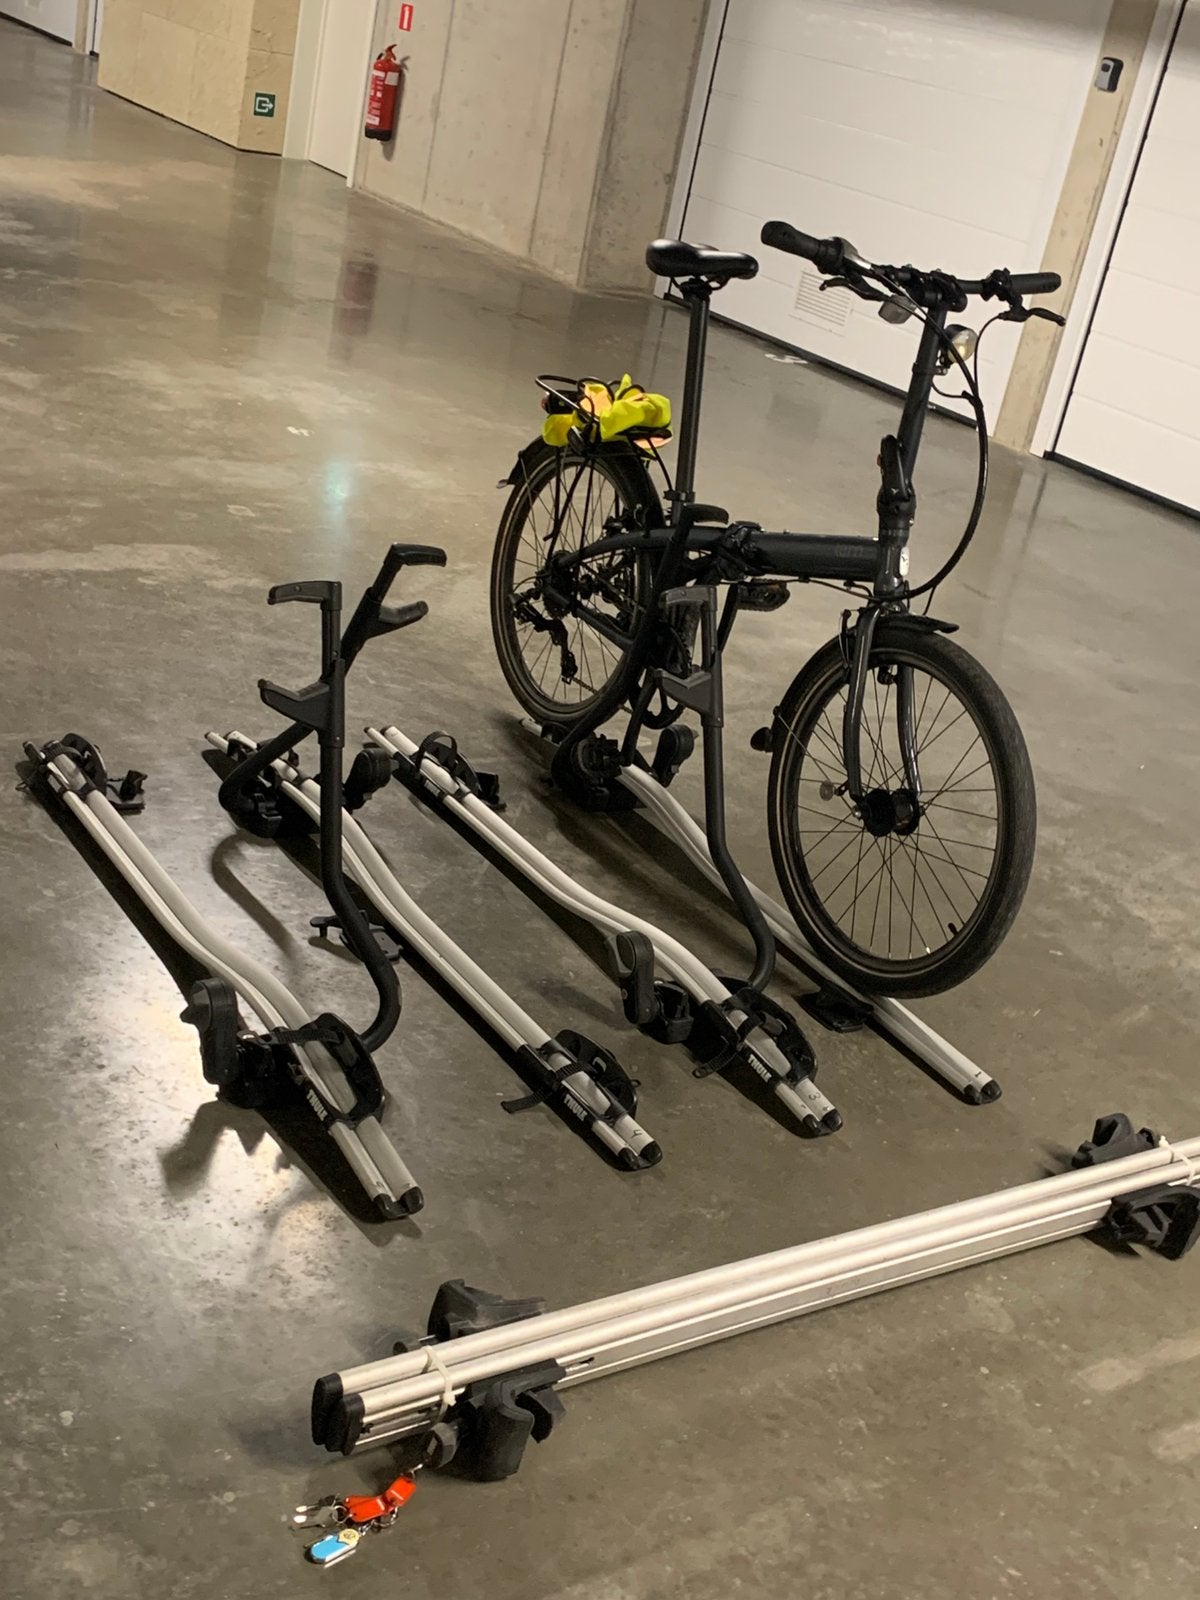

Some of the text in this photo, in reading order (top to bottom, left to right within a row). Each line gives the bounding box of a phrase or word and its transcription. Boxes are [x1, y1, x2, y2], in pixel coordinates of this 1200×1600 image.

[748, 1053, 772, 1082] THULE
[306, 1088, 328, 1121] THULE
[563, 1093, 588, 1122] THULE
